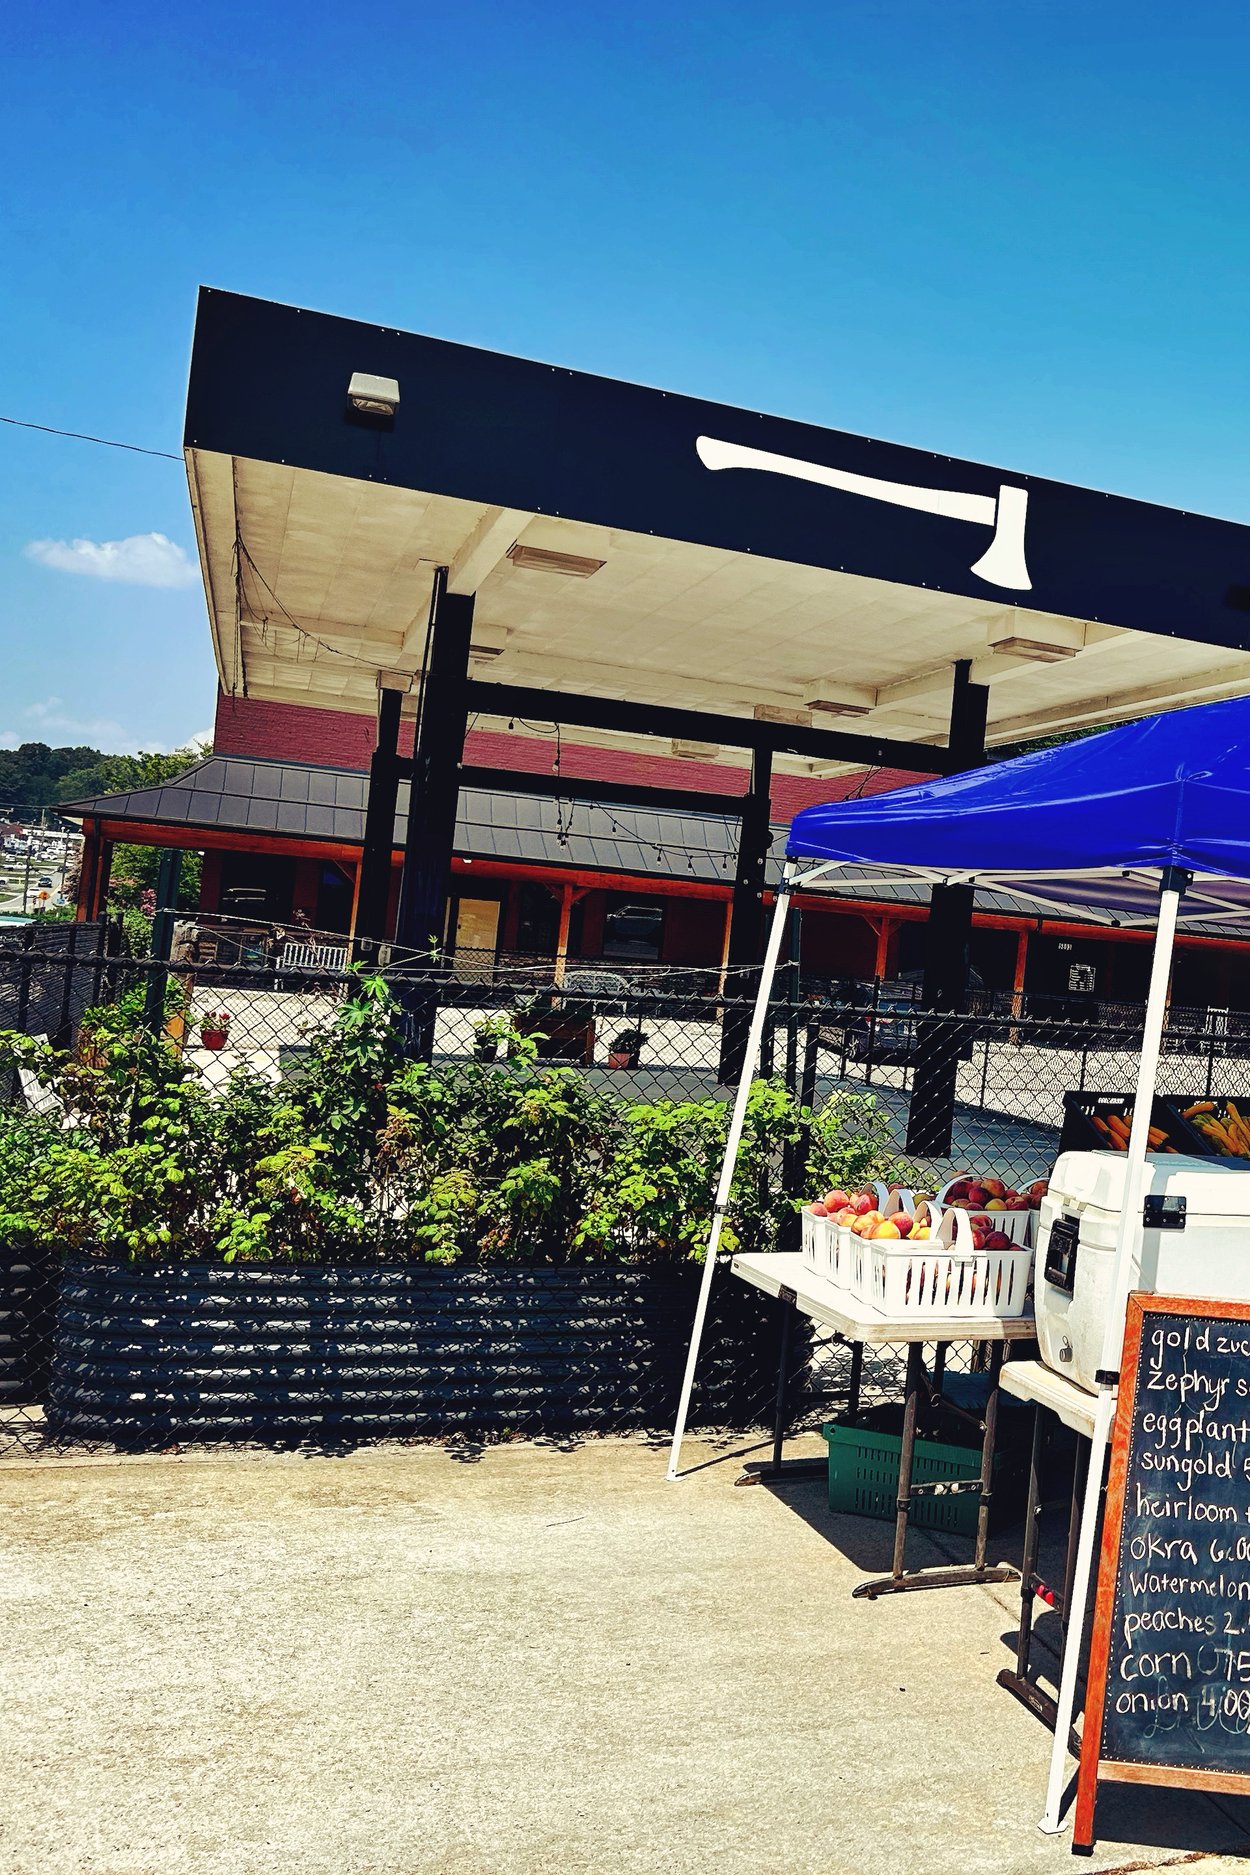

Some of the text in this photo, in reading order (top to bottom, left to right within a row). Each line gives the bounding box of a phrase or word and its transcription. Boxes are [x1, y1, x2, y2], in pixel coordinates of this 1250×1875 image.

[1151, 1326, 1211, 1369] gold
[1141, 1451, 1232, 1491] sungold
[1137, 1484, 1237, 1522] heirloom
[1124, 1608, 1215, 1649] peaches
[1120, 1651, 1192, 1681] corn
[1116, 1691, 1189, 1714] onion
